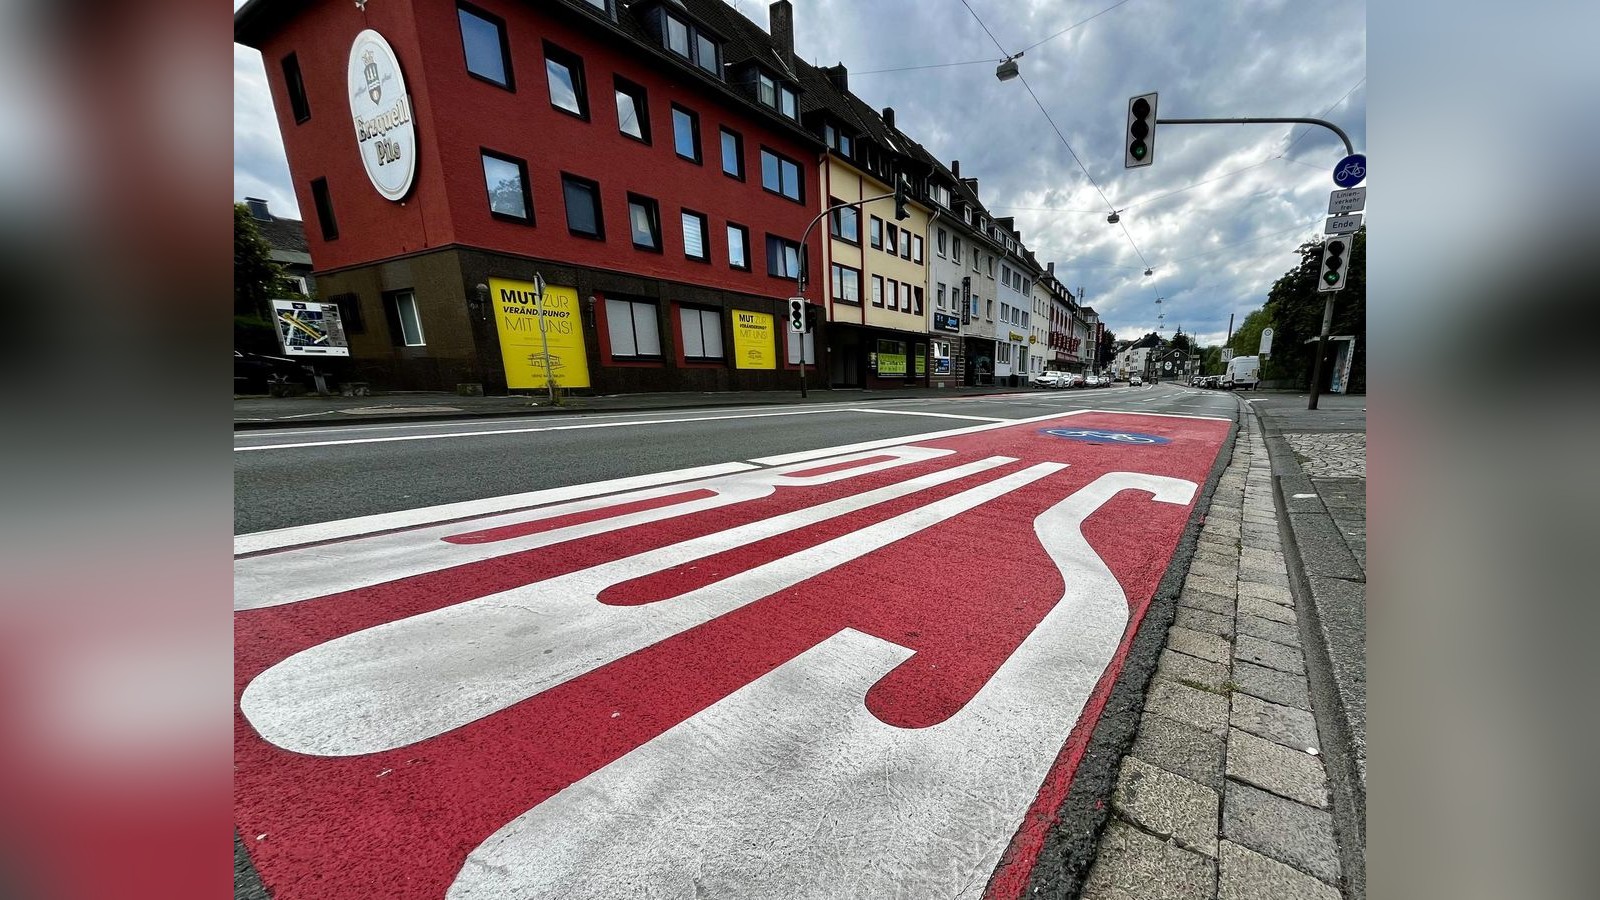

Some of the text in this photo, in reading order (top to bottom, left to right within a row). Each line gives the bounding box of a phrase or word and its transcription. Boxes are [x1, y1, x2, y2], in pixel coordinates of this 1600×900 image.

[355, 94, 410, 142] Erzquell
[375, 138, 401, 166] Pils
[500, 289, 569, 309] MUT ZUR
[503, 306, 570, 318] VERÄNDRUNG?
[740, 314, 753, 323] MUT
[505, 316, 574, 335] MIT UNS!
[234, 444, 1199, 900] BUS
